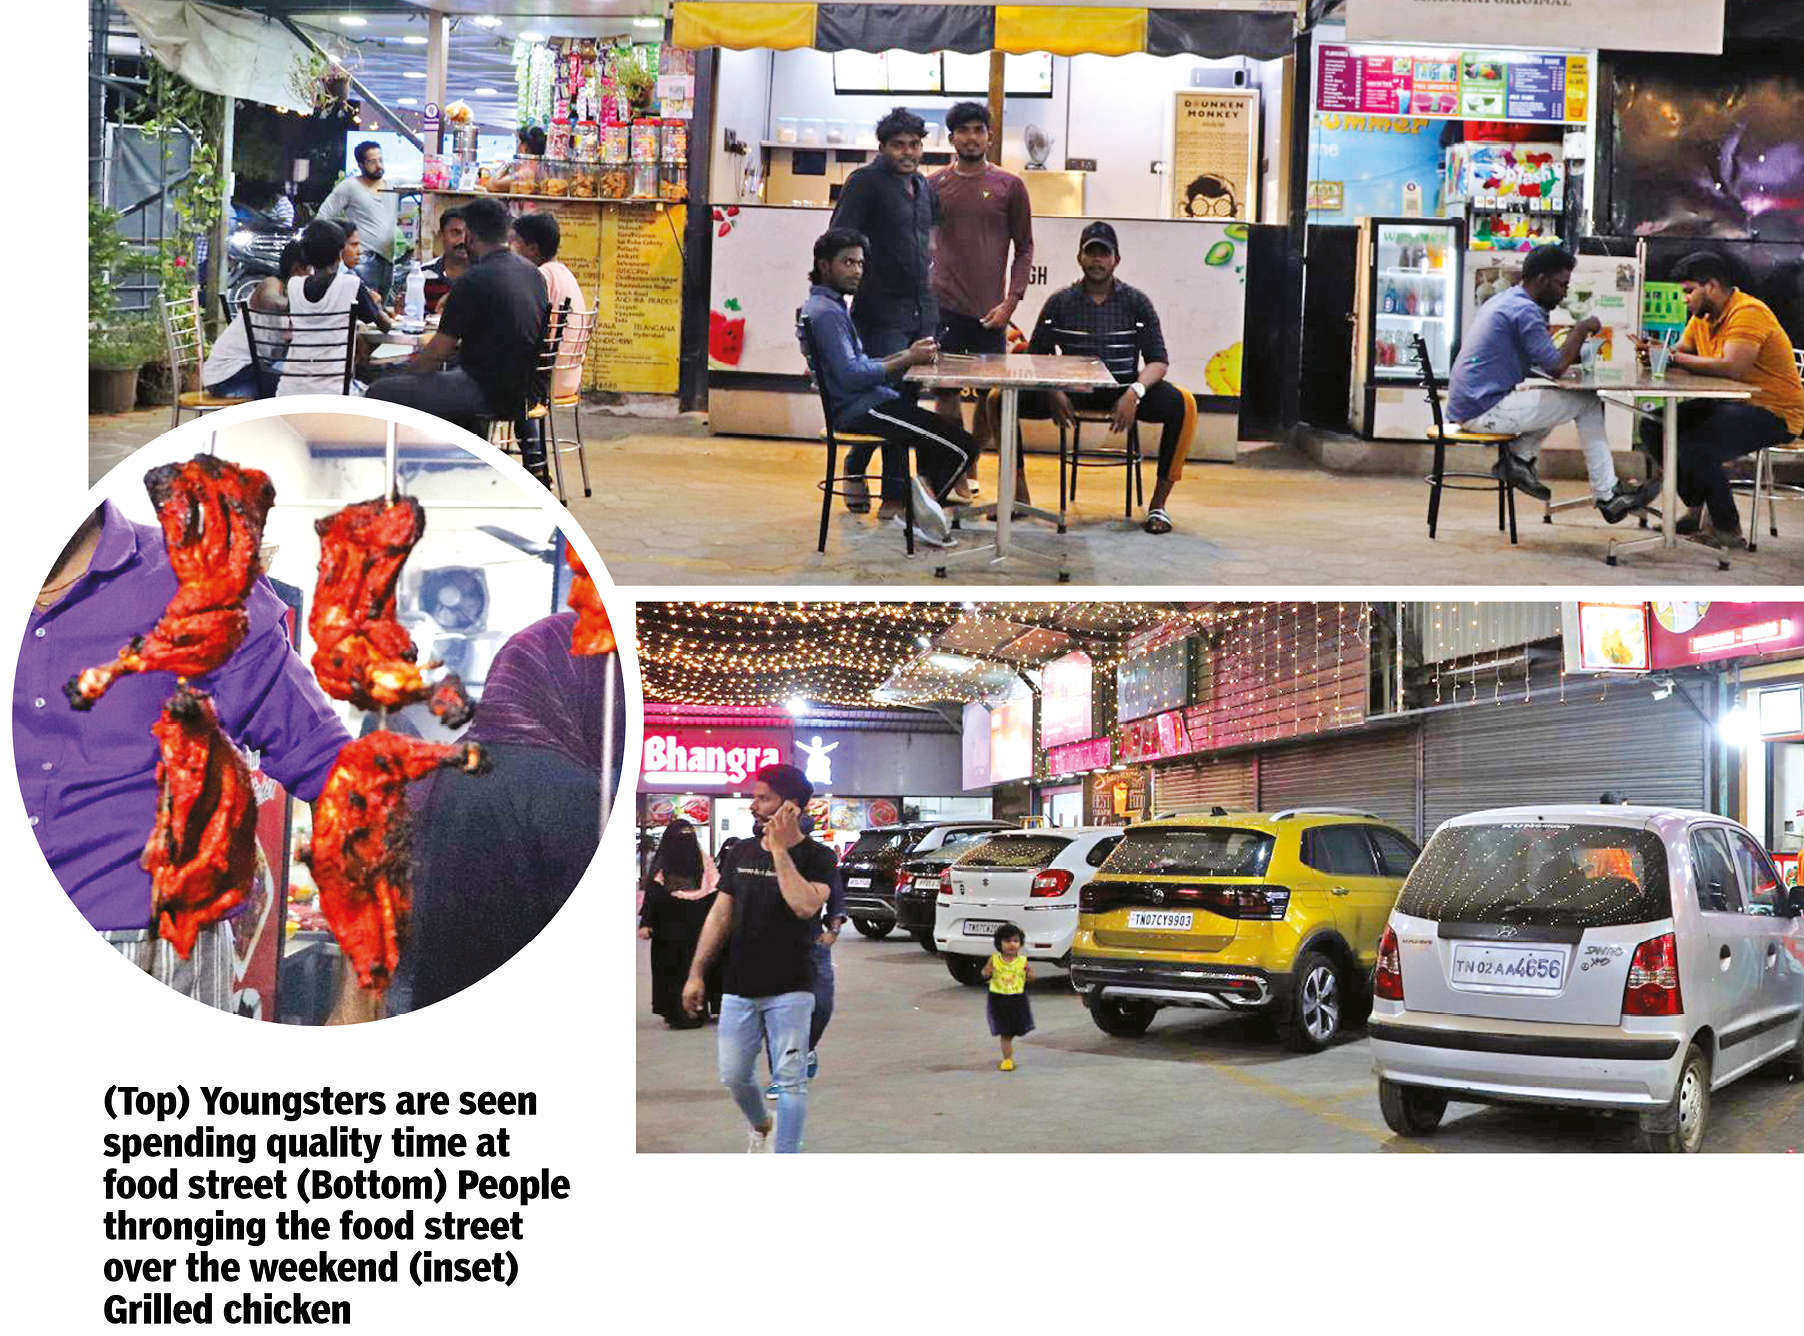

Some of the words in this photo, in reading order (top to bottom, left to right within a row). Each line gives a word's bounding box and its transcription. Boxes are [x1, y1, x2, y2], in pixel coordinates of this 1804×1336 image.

[1188, 110, 1239, 119] MONKEY
[1320, 113, 1429, 134] ummer
[644, 735, 780, 783] Bhangra
[1135, 914, 1192, 927] TN07CY9903
